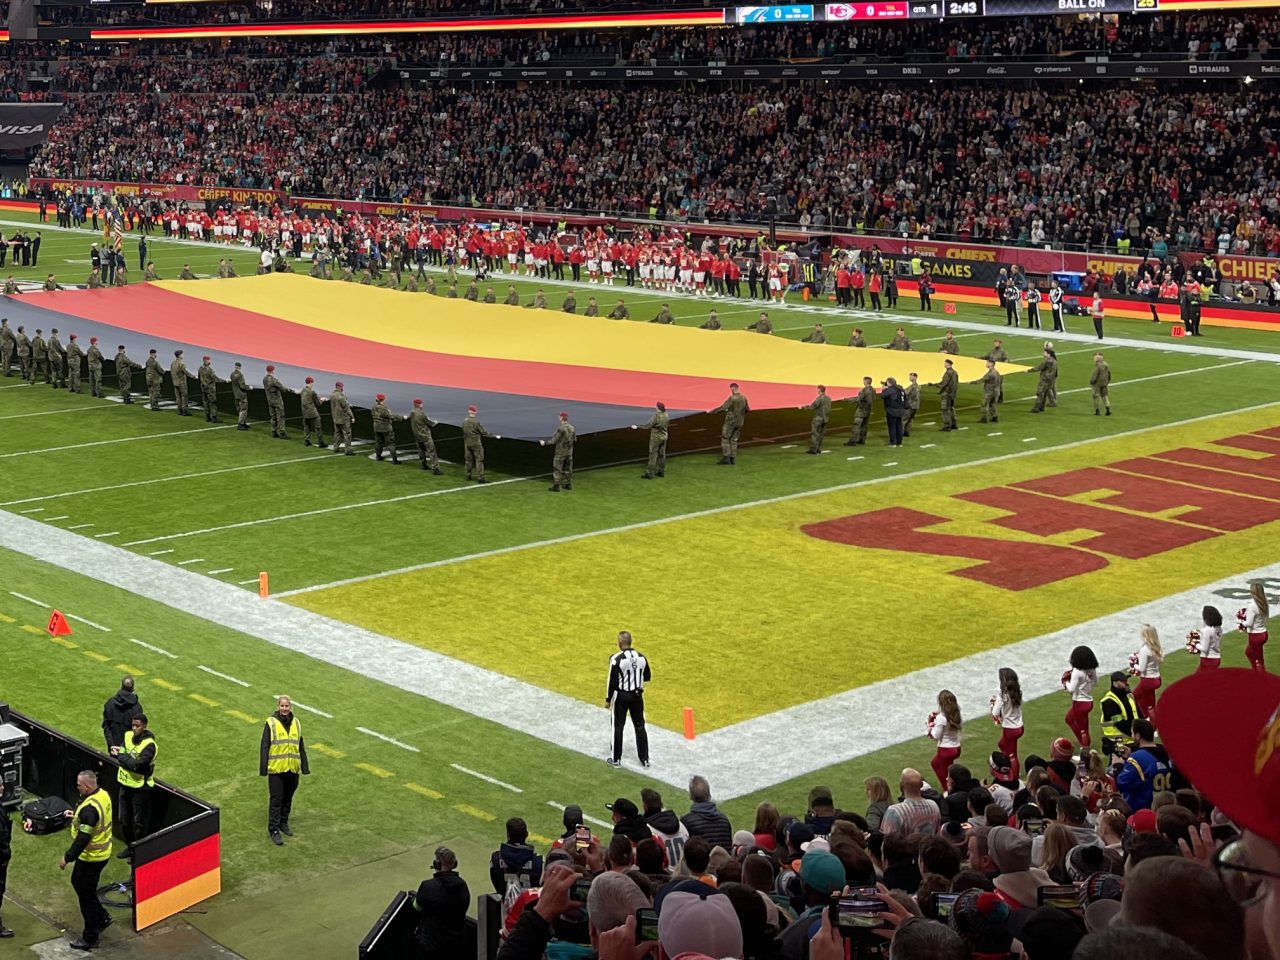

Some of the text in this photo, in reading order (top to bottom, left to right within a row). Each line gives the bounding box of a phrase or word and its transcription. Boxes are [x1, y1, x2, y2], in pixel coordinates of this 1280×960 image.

[774, 8, 782, 19] 0
[866, 6, 875, 16] 0
[930, 3, 938, 14] 1
[950, 2, 977, 14] 2:43
[198, 189, 230, 201] CHIEFS
[946, 248, 996, 262] CHIEFS
[1219, 258, 1277, 280] CHIEF
[1173, 326, 1182, 336] 10
